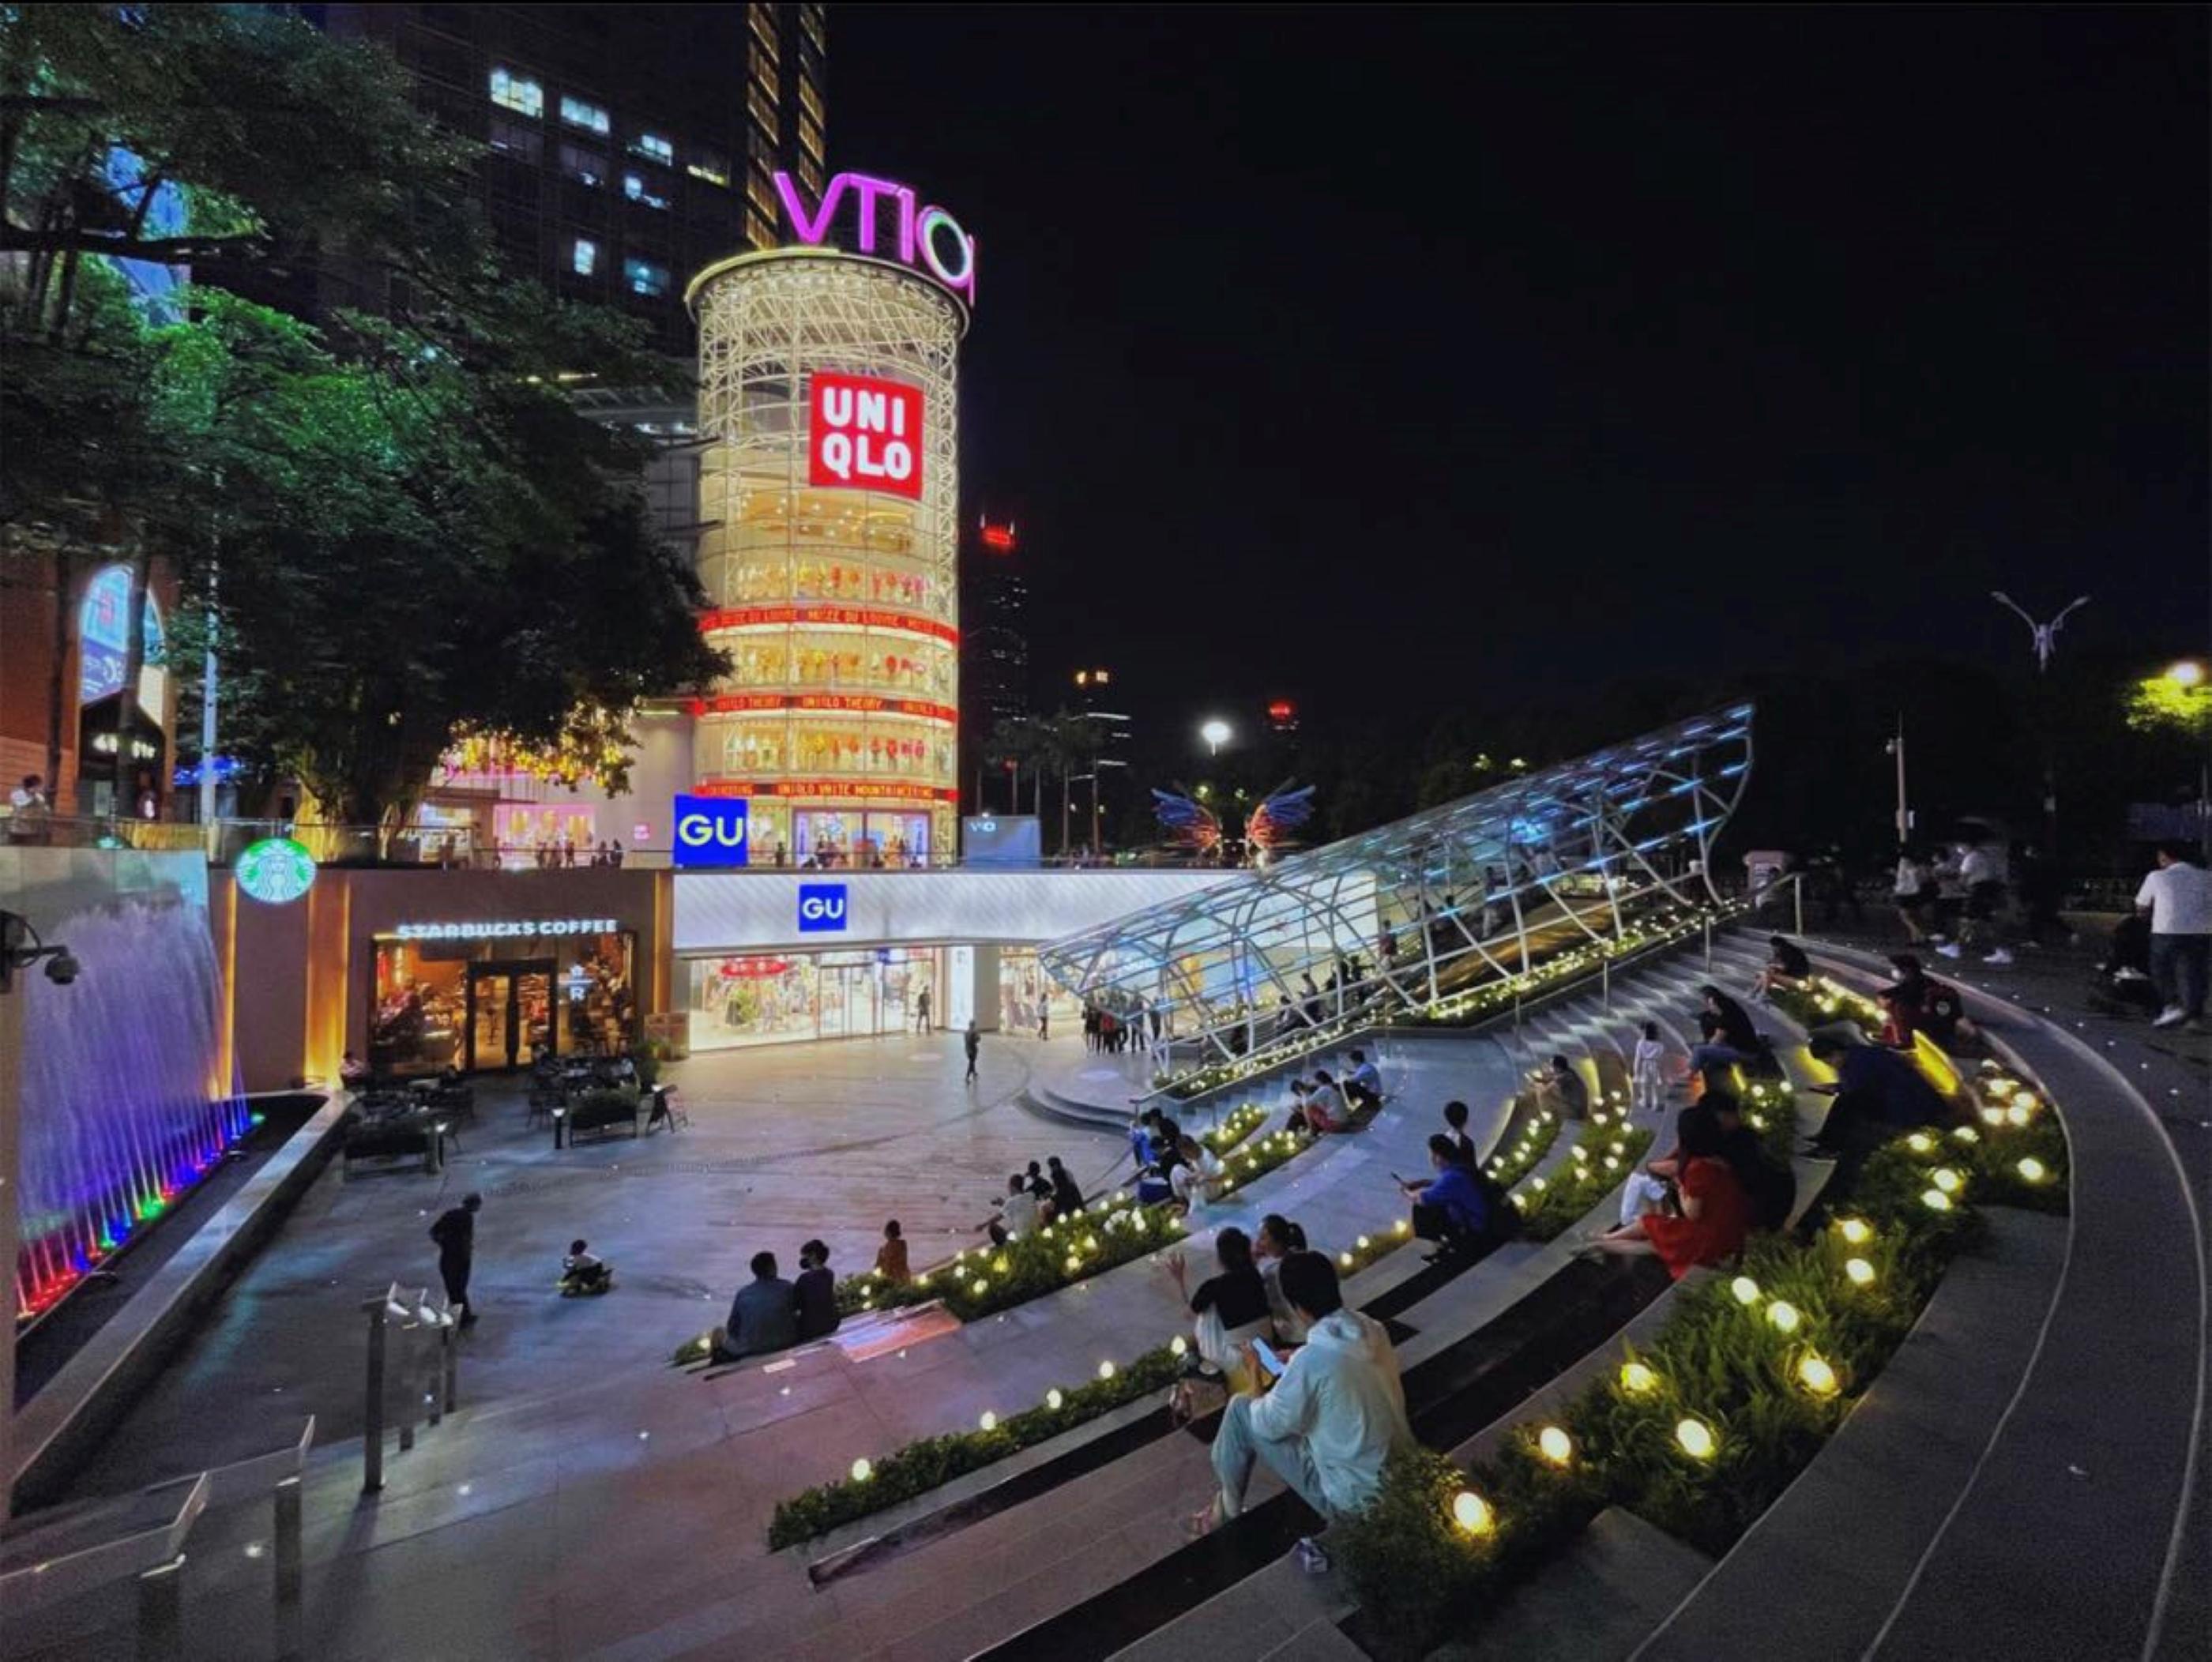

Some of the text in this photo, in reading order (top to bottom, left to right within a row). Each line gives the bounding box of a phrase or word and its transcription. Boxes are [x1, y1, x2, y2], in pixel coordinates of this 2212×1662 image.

[822, 386, 905, 437] UNI
[822, 432, 912, 480] QLO
[679, 814, 744, 847] GU
[802, 897, 845, 919] GU
[397, 919, 618, 939] STARBUCKS COFFEE
